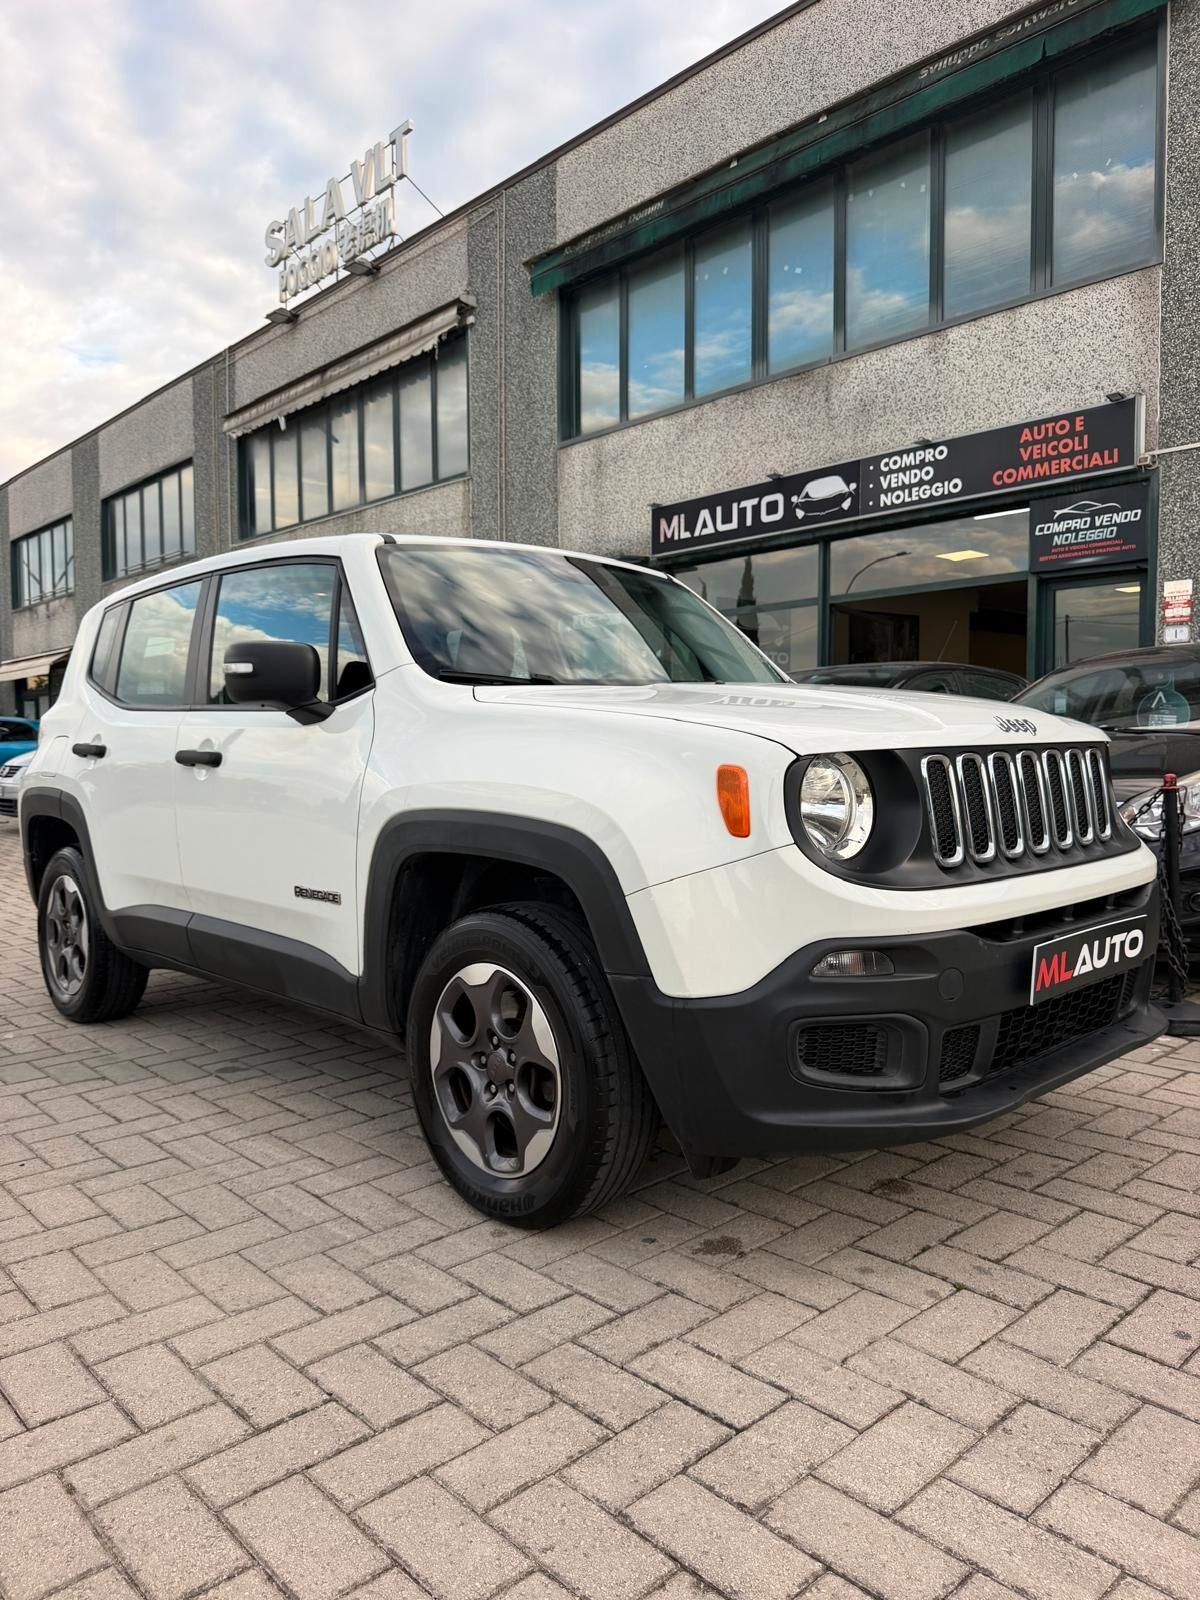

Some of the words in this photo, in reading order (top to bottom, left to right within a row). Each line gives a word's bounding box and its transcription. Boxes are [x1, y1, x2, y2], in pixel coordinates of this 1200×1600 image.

[264, 175, 346, 268] SALA
[350, 118, 415, 207] VLT
[1020, 419, 1071, 443] AUTO
[1075, 416, 1085, 432] E
[880, 445, 948, 471] COMPRO
[1020, 435, 1089, 461] VEICOLI
[880, 466, 934, 489] VENDO
[992, 448, 1119, 486] COMMERCIALI
[880, 478, 962, 507] NOLEGGIO
[1035, 517, 1091, 536] COMPRO
[1095, 509, 1142, 526] VENDO
[1052, 526, 1118, 546] NOLEGGIO
[994, 715, 1037, 736] Jeep
[294, 886, 341, 905] RENEGADE
